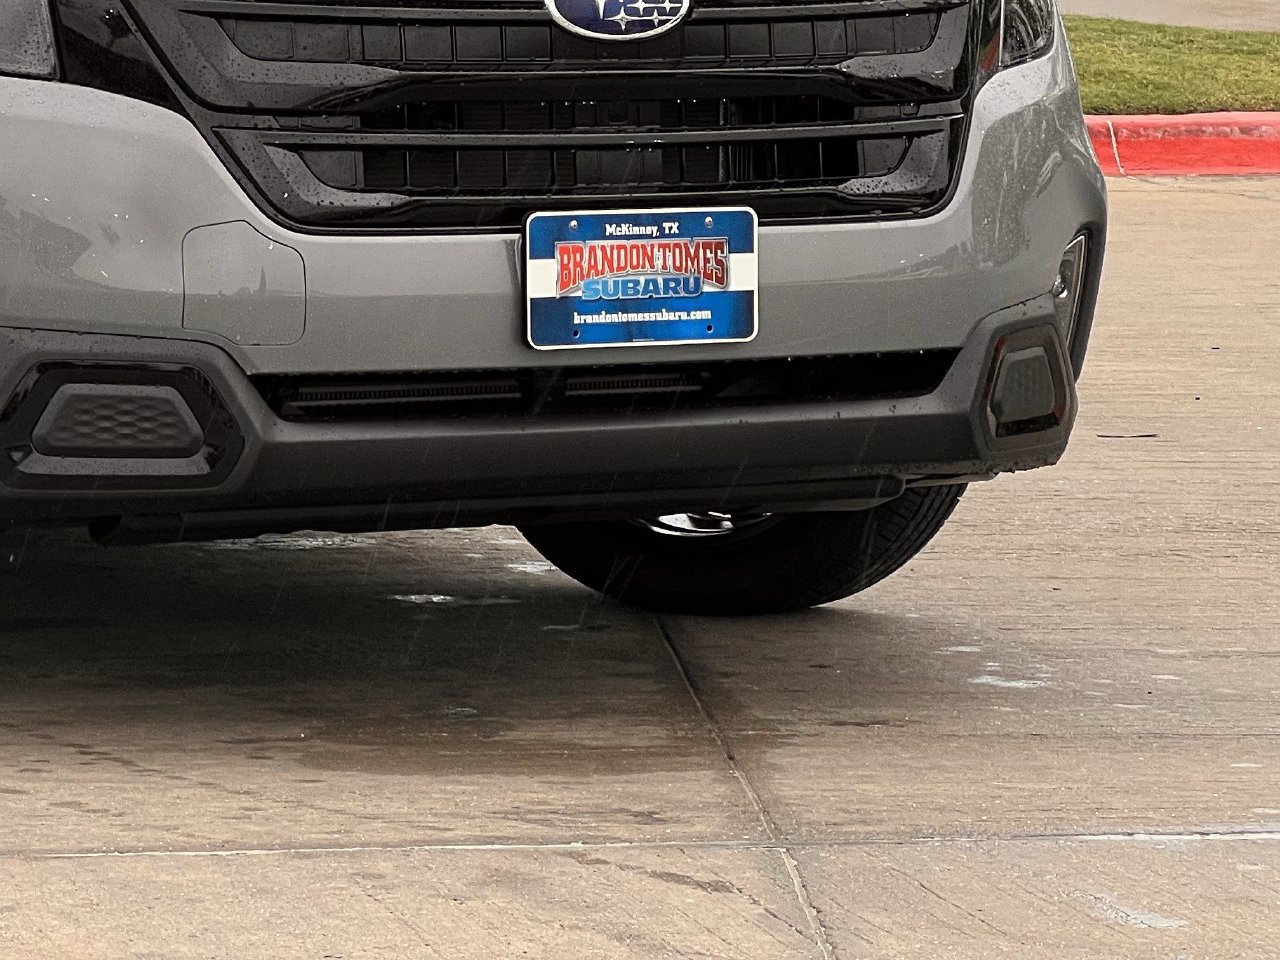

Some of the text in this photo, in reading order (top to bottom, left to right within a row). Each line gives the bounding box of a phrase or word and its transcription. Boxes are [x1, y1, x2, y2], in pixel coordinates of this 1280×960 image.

[605, 221, 680, 237] McKinney, TX
[557, 239, 727, 293] BRANDON TOMES
[581, 276, 703, 300] SUBARU
[573, 309, 712, 325] brandontomessubaru.com
